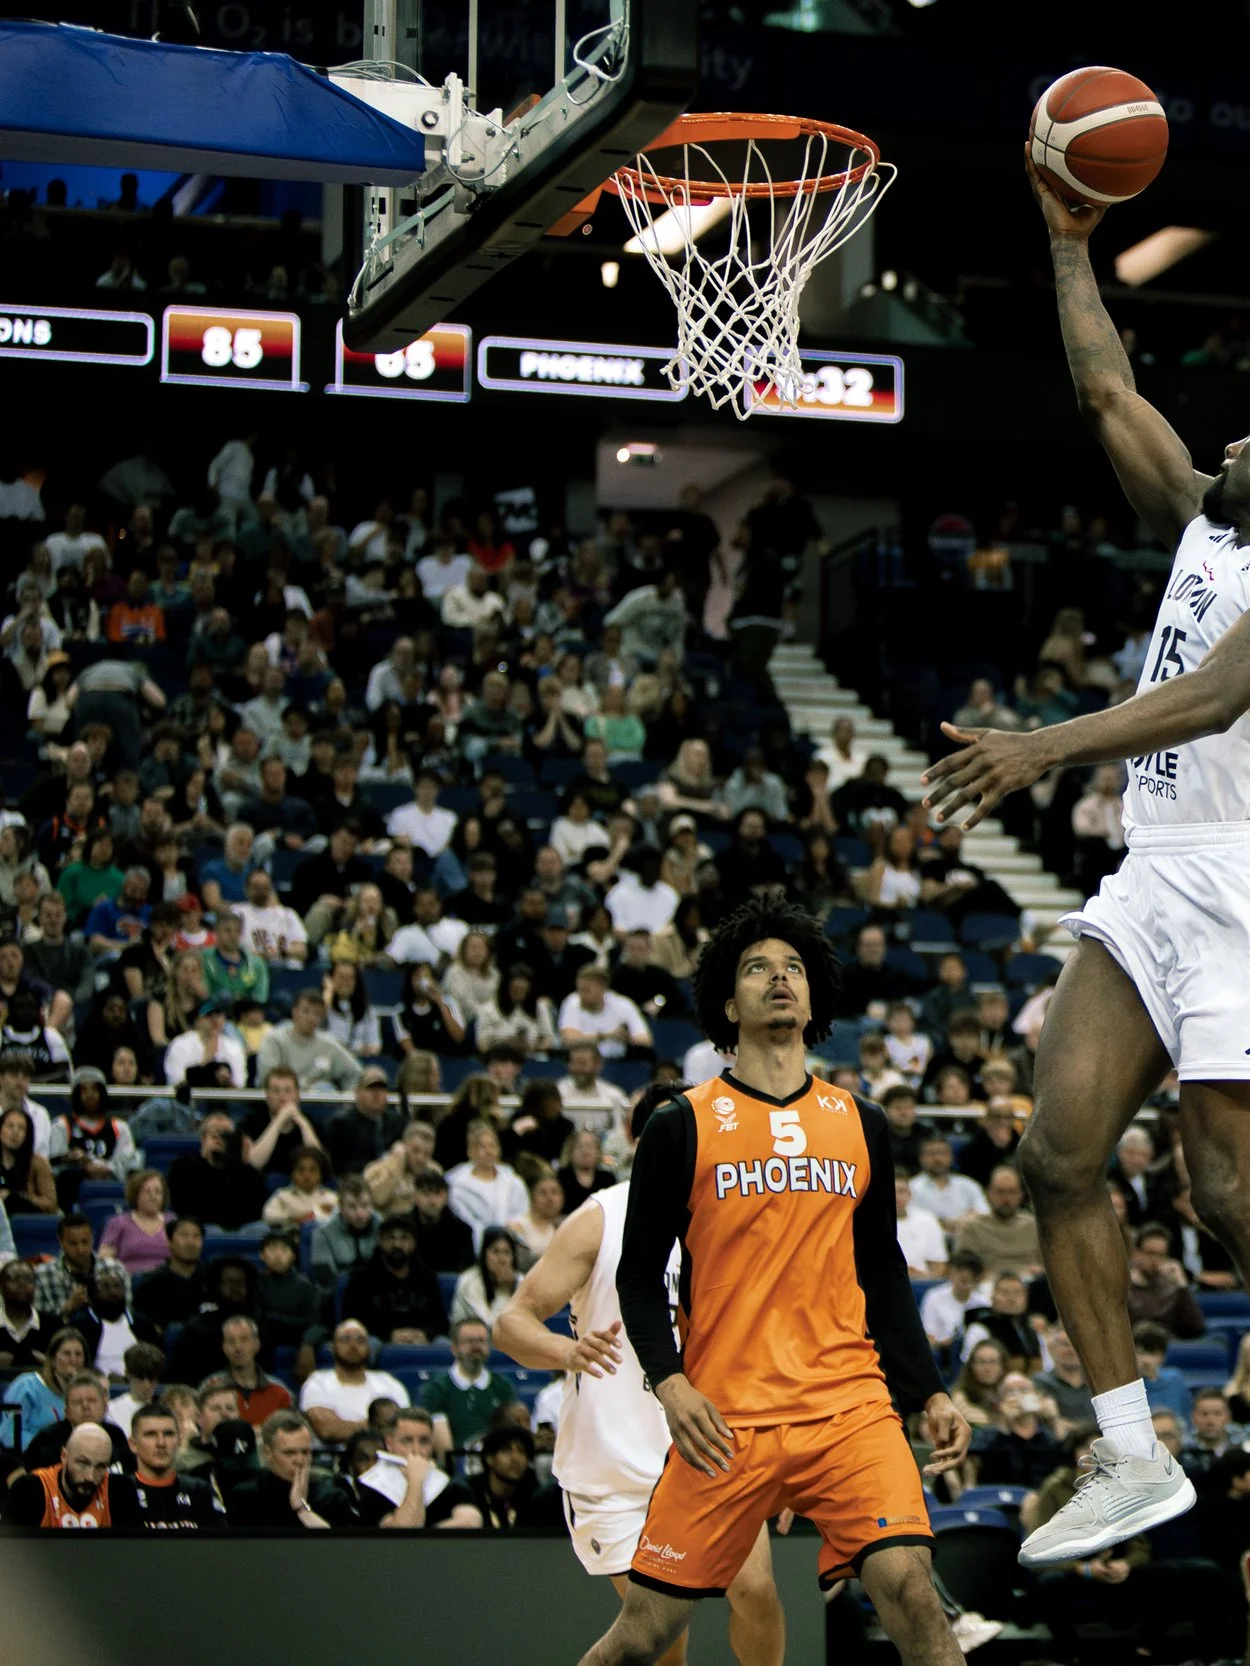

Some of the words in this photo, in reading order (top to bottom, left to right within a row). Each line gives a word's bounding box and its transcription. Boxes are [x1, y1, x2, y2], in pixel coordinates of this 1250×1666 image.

[282, 5, 315, 46] is
[203, 326, 263, 368] 85
[521, 353, 643, 384] PHOENIX
[1149, 625, 1187, 682] 15
[1136, 774, 1177, 801] PORTS
[769, 1110, 807, 1157] 5
[715, 1156, 857, 1200] PHOENIX
[661, 1543, 687, 1562] Lloyd
